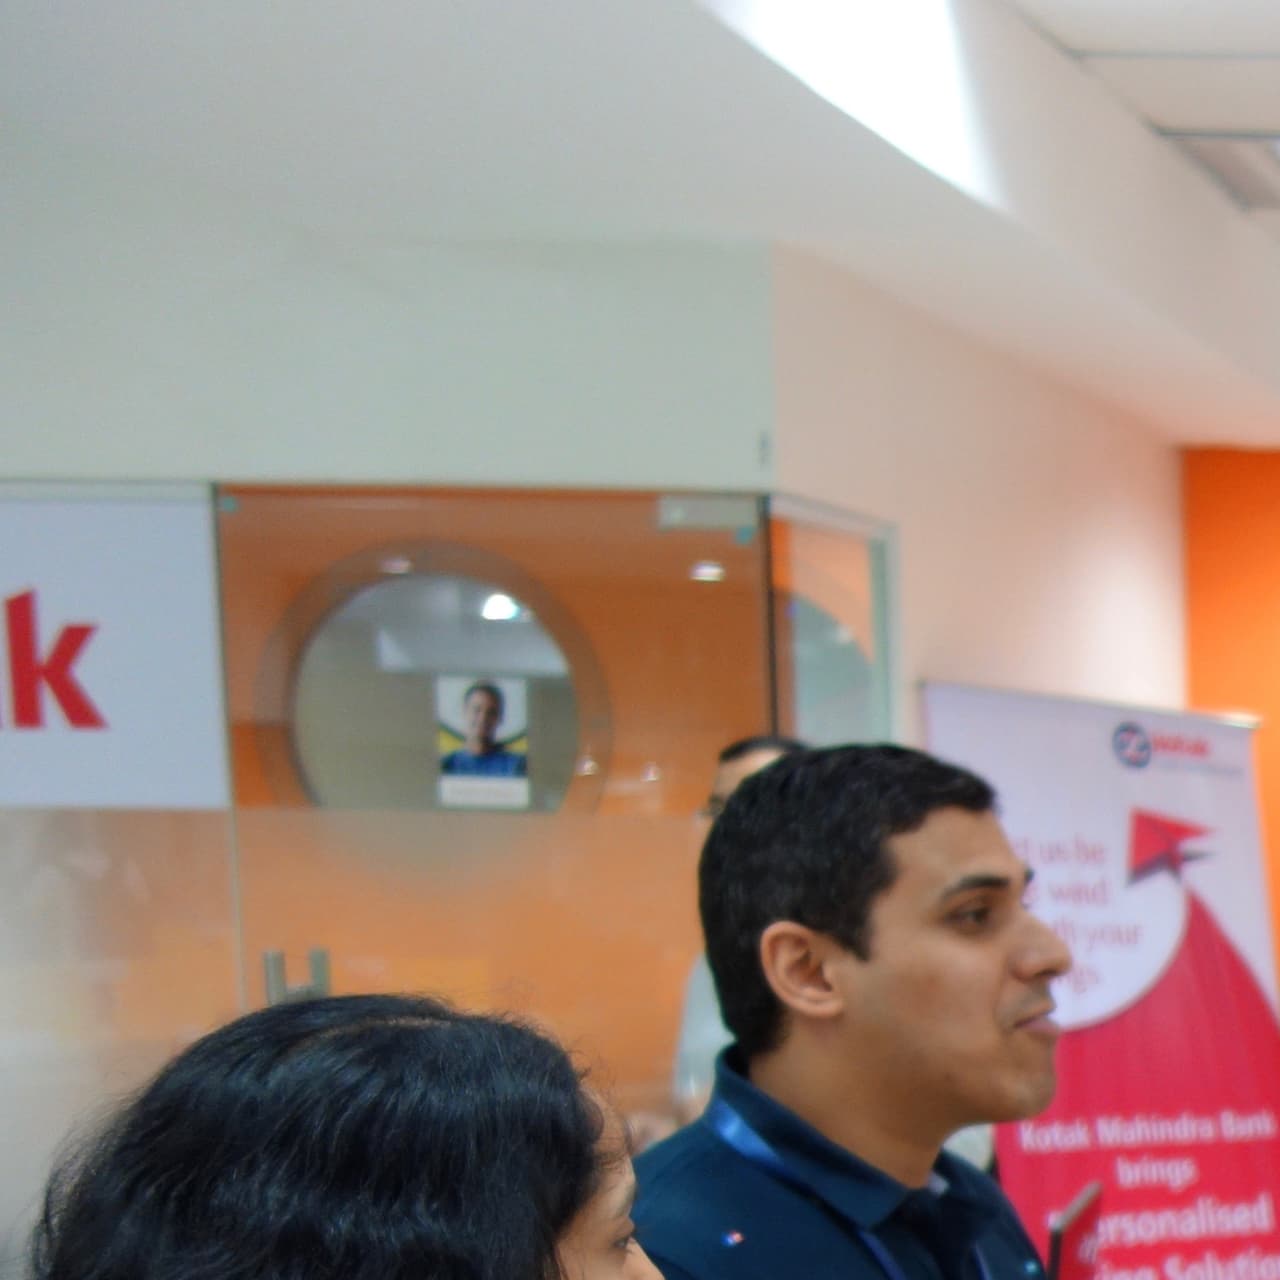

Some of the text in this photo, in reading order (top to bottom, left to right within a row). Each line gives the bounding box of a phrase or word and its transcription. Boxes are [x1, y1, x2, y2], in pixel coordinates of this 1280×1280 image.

[0, 588, 107, 731] k
[1018, 1121, 1090, 1152] Kotak
[1096, 1112, 1214, 1147] Mahindra
[1115, 1155, 1197, 1191] brings
